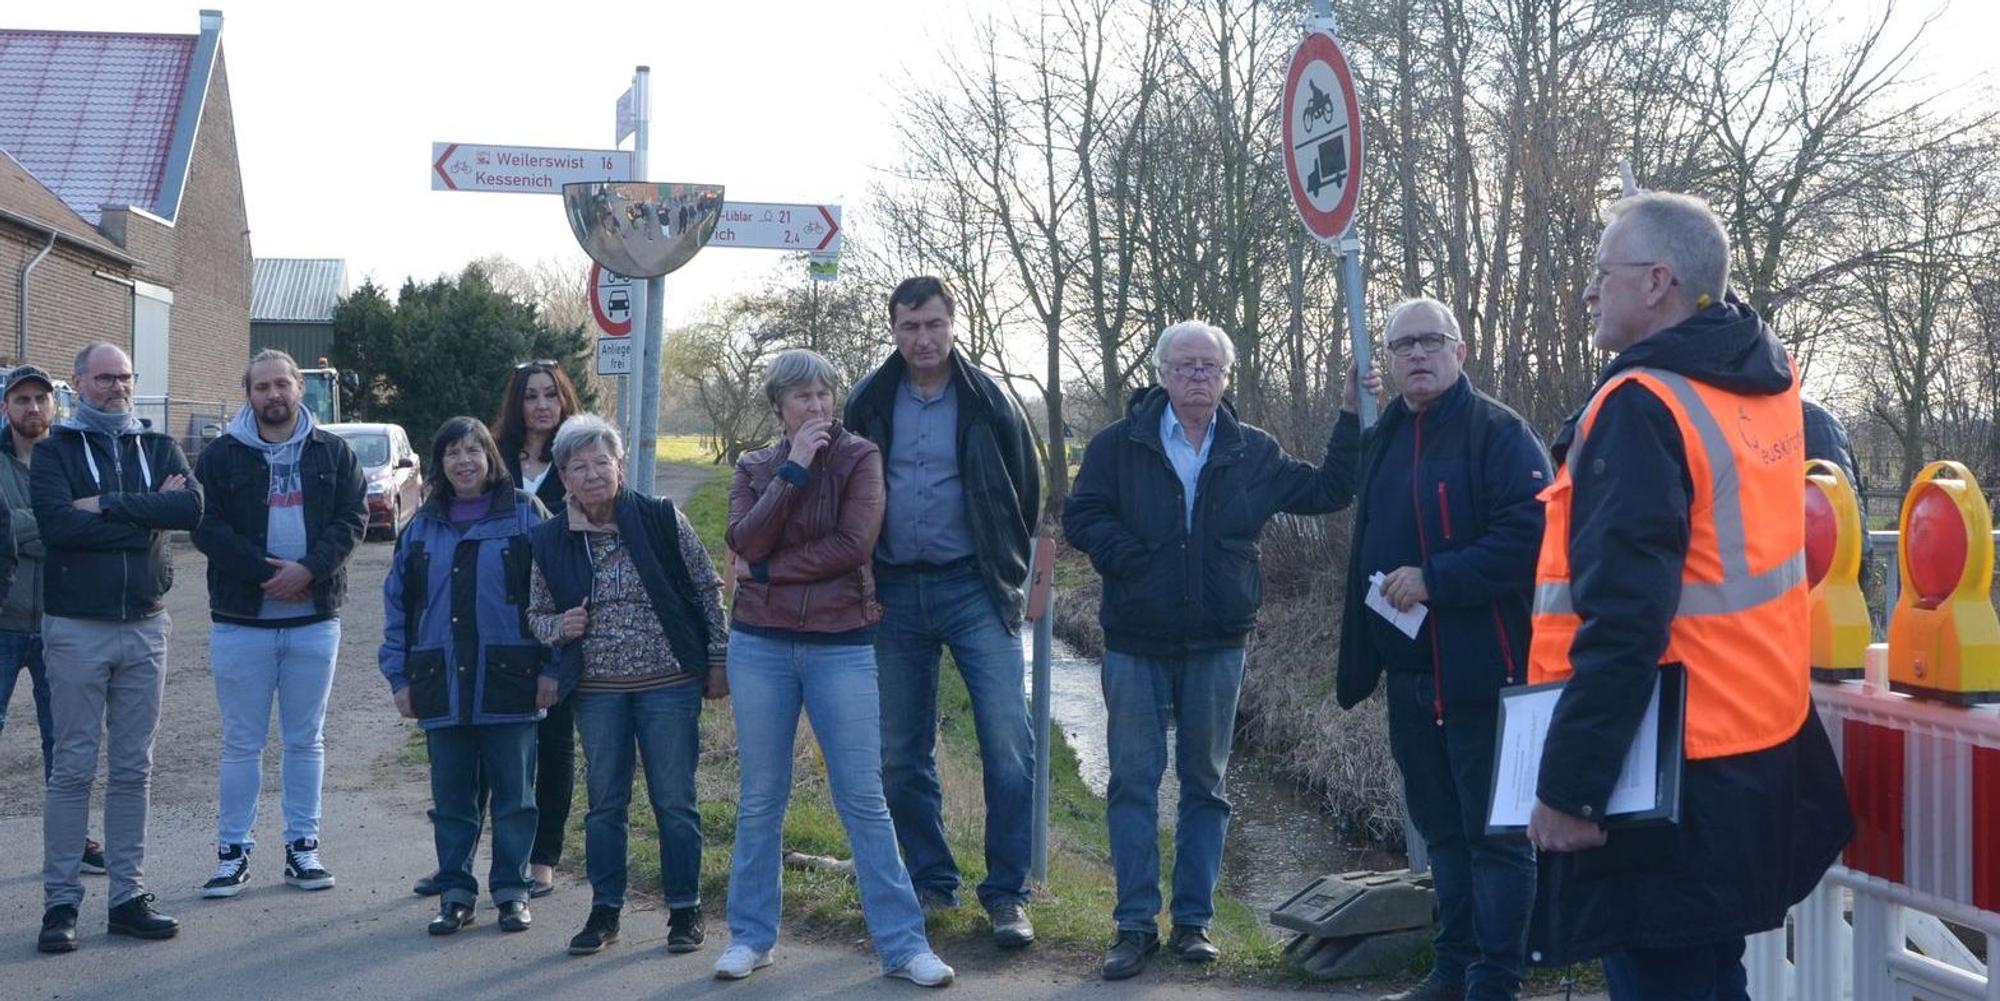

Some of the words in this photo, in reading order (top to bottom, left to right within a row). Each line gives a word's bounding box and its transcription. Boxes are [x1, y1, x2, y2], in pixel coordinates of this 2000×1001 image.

[496, 152, 585, 169] Weilerswist
[601, 156, 614, 171] 16
[475, 172, 553, 188] Kessenich
[779, 210, 791, 223] 21
[610, 358, 625, 369] frei
